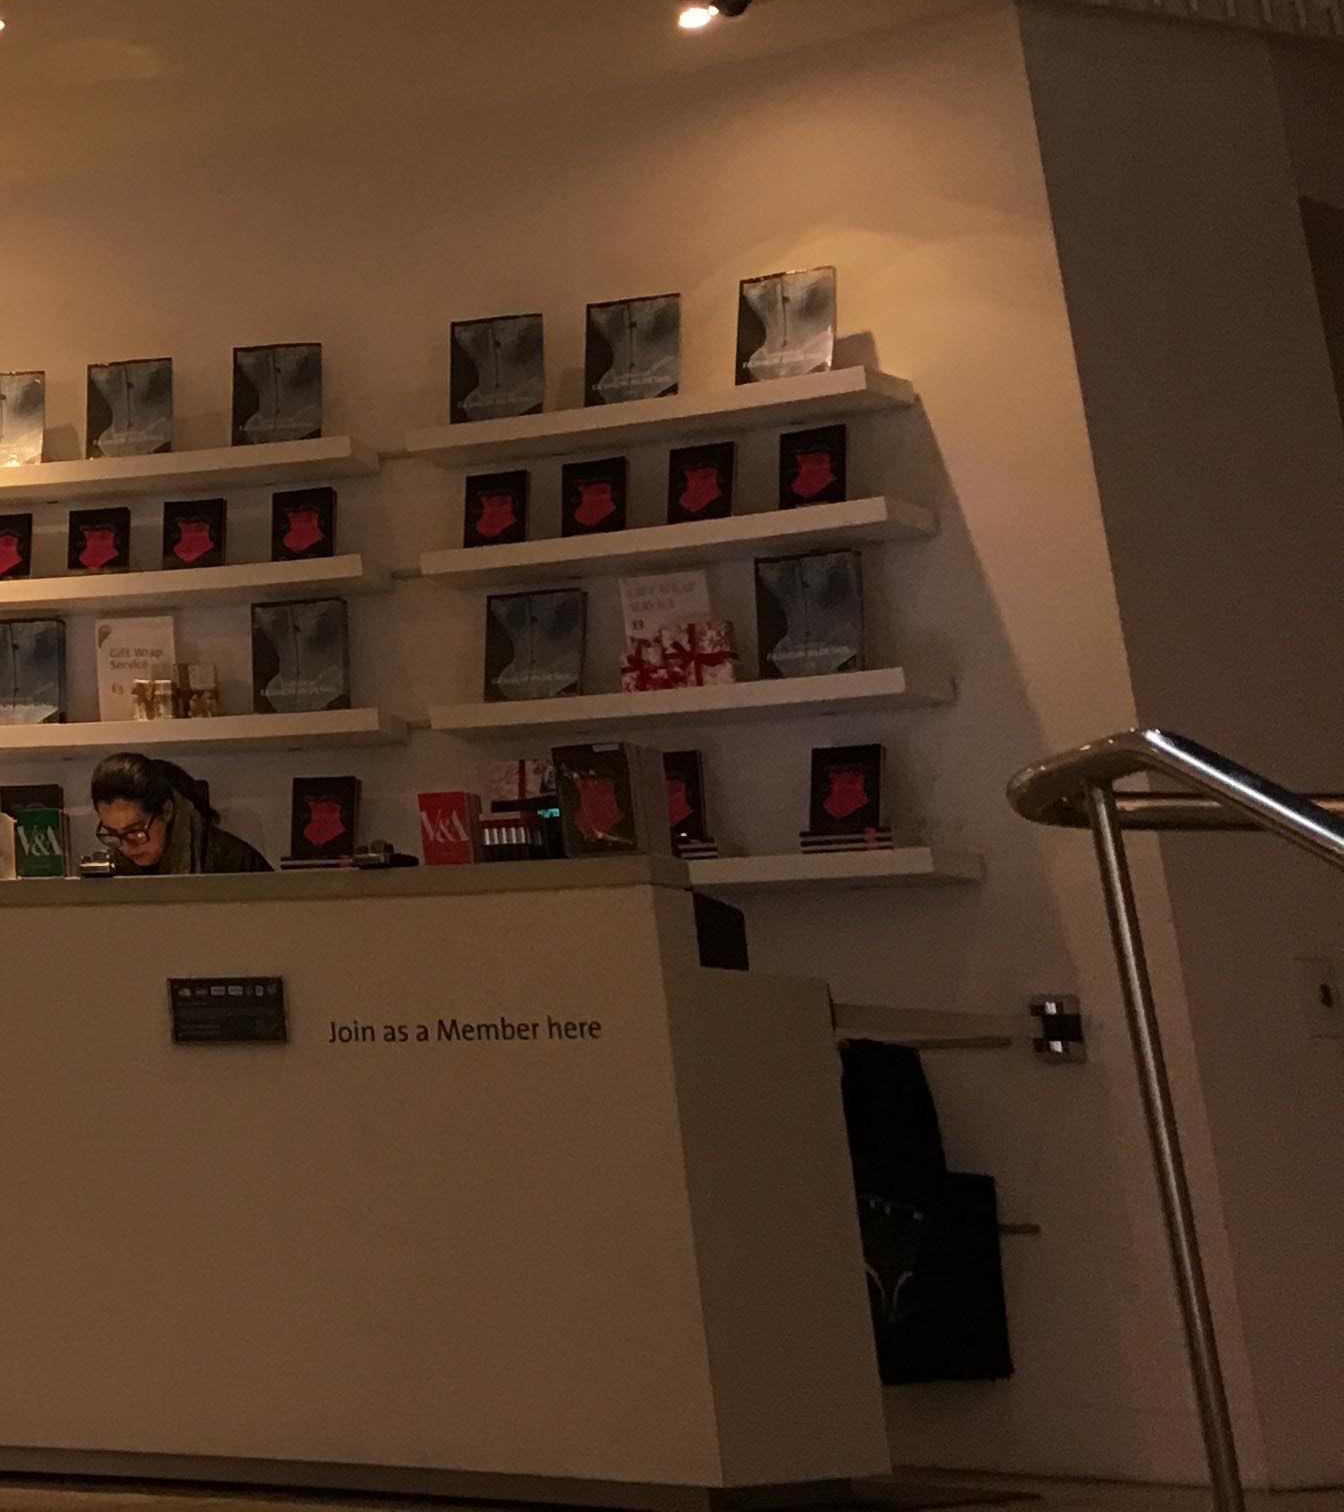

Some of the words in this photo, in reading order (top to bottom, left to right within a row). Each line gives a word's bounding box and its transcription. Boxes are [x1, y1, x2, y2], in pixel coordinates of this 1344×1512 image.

[17, 825, 64, 857] V&A
[421, 810, 468, 842] V&A
[329, 1021, 375, 1042] Join
[383, 1025, 409, 1042] as
[416, 1025, 429, 1042] a
[437, 1017, 540, 1041] Member
[547, 1016, 602, 1040] here
